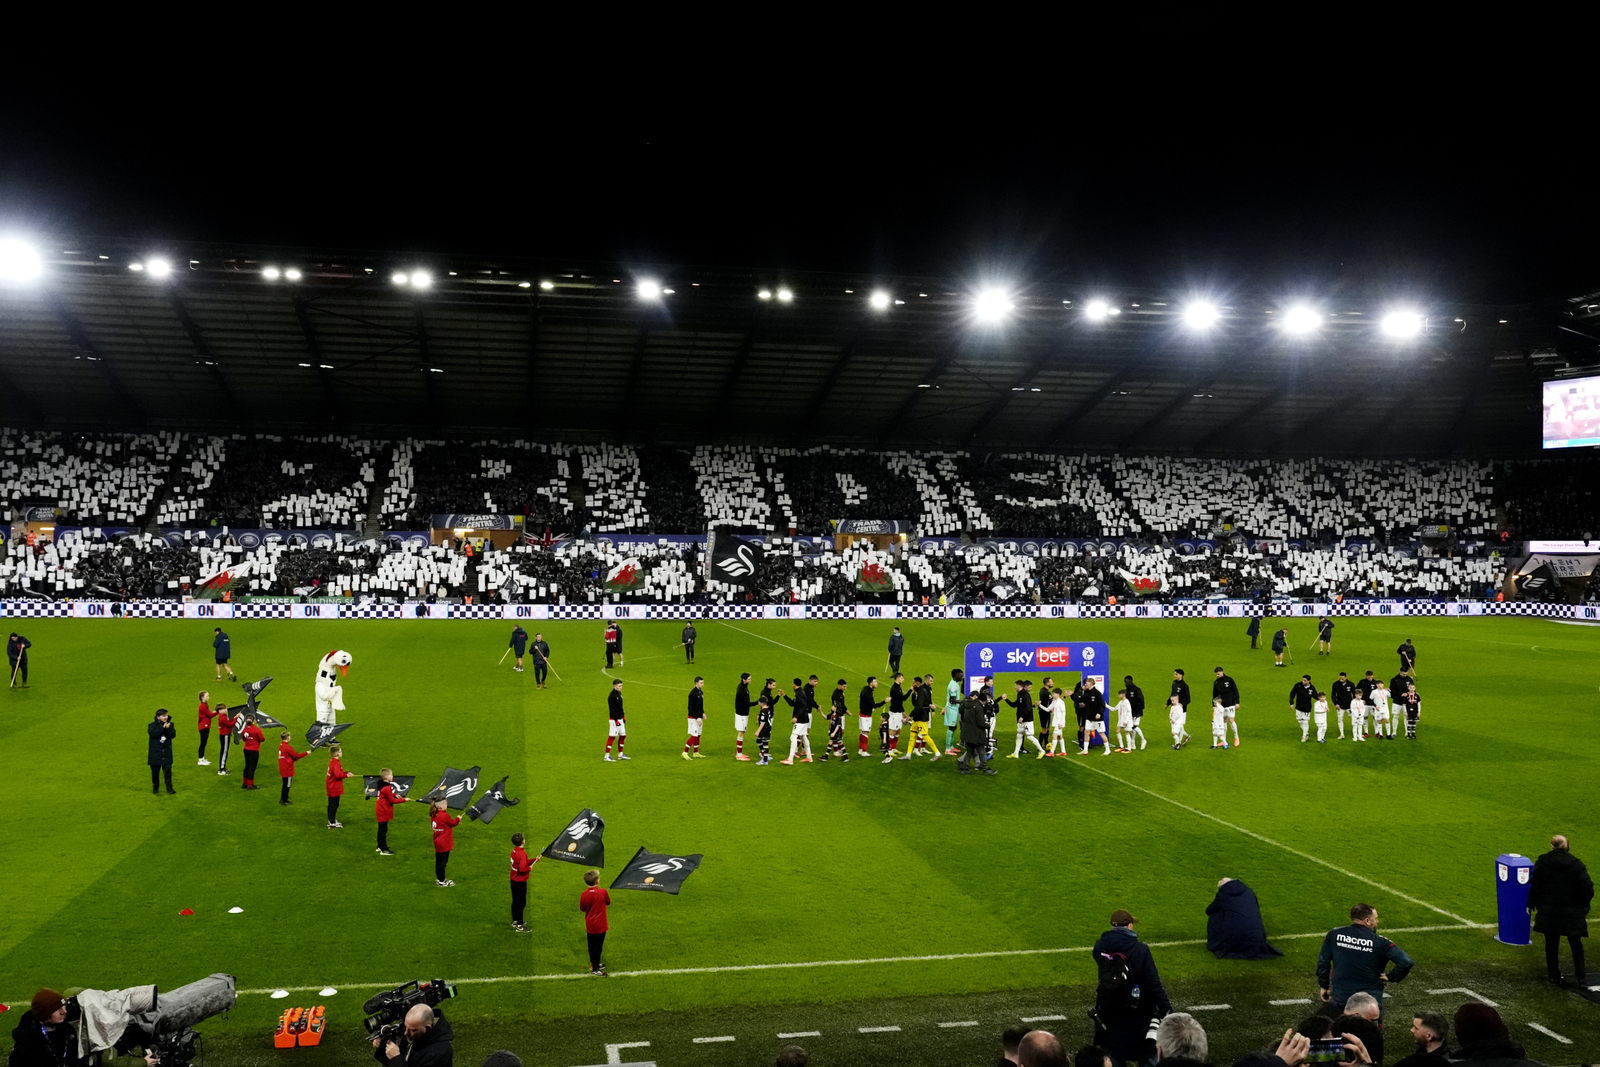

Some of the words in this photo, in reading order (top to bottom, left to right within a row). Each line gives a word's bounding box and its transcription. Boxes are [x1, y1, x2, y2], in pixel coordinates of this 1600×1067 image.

[463, 514, 497, 522] TRADE
[466, 520, 495, 528] CENTRE
[855, 525, 881, 533] CENTRE
[675, 542, 708, 551] CENRE
[88, 604, 104, 616] ON
[198, 605, 214, 616] ON
[304, 605, 320, 616] ON
[516, 606, 532, 617] ON
[615, 606, 630, 617] ON
[776, 606, 790, 617] ON
[867, 606, 882, 617] ON
[1051, 606, 1065, 616] ON
[1135, 606, 1148, 616] ON
[1302, 605, 1314, 615] ON
[1379, 605, 1392, 614] ON
[1584, 607, 1597, 618] ON
[1006, 648, 1034, 666] sky
[1039, 649, 1066, 663] bet
[1336, 934, 1373, 947] macron
[1336, 942, 1362, 951] WREXHAM
